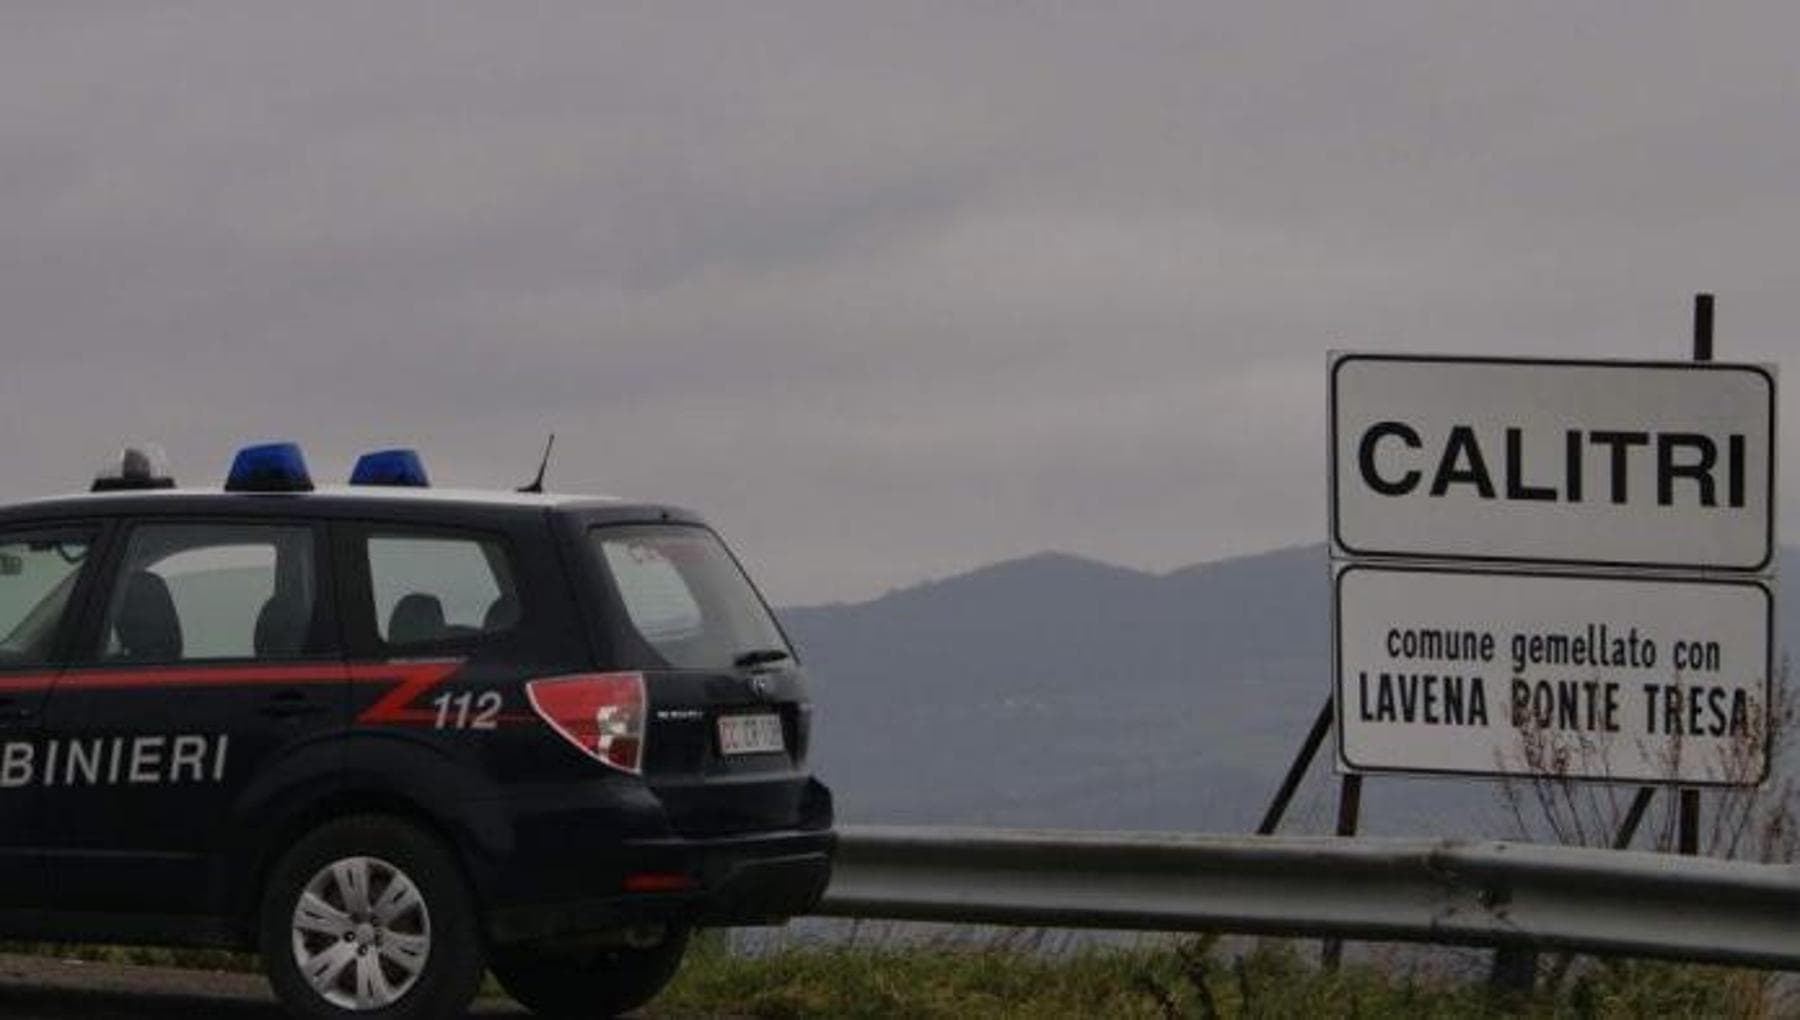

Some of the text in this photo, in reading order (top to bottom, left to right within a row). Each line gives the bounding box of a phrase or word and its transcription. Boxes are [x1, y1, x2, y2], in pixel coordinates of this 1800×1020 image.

[1358, 420, 1746, 508] CALITRI
[1387, 624, 1720, 674] comune gemellato con
[433, 690, 503, 731] 112
[1359, 671, 1750, 738] LAVENA PONTE TRESA
[0, 734, 229, 788] BINIERI
